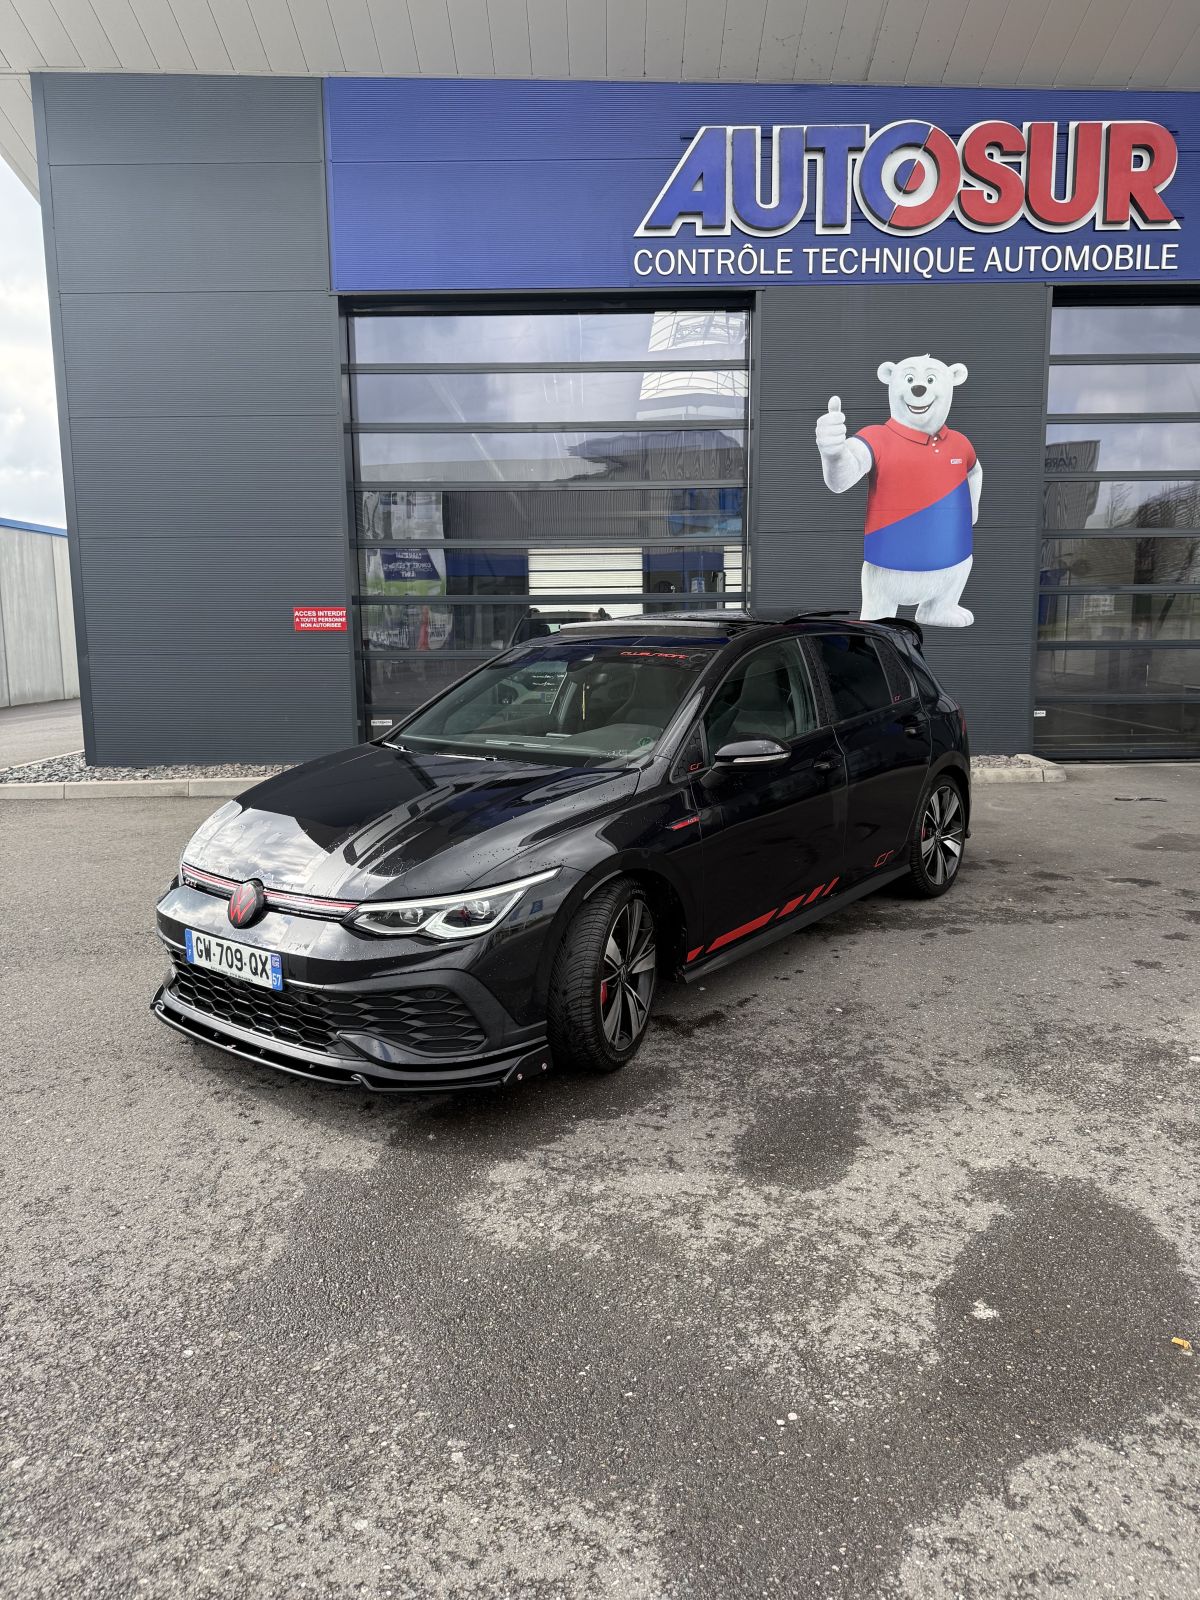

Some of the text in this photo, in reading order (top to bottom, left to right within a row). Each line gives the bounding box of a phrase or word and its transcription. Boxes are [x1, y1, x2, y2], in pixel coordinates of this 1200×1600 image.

[633, 119, 1182, 237] AUTOSUR
[633, 243, 1180, 279] CONTRÔLE TECHNIQUE AUTOMOBILE
[272, 973, 281, 986] 57
